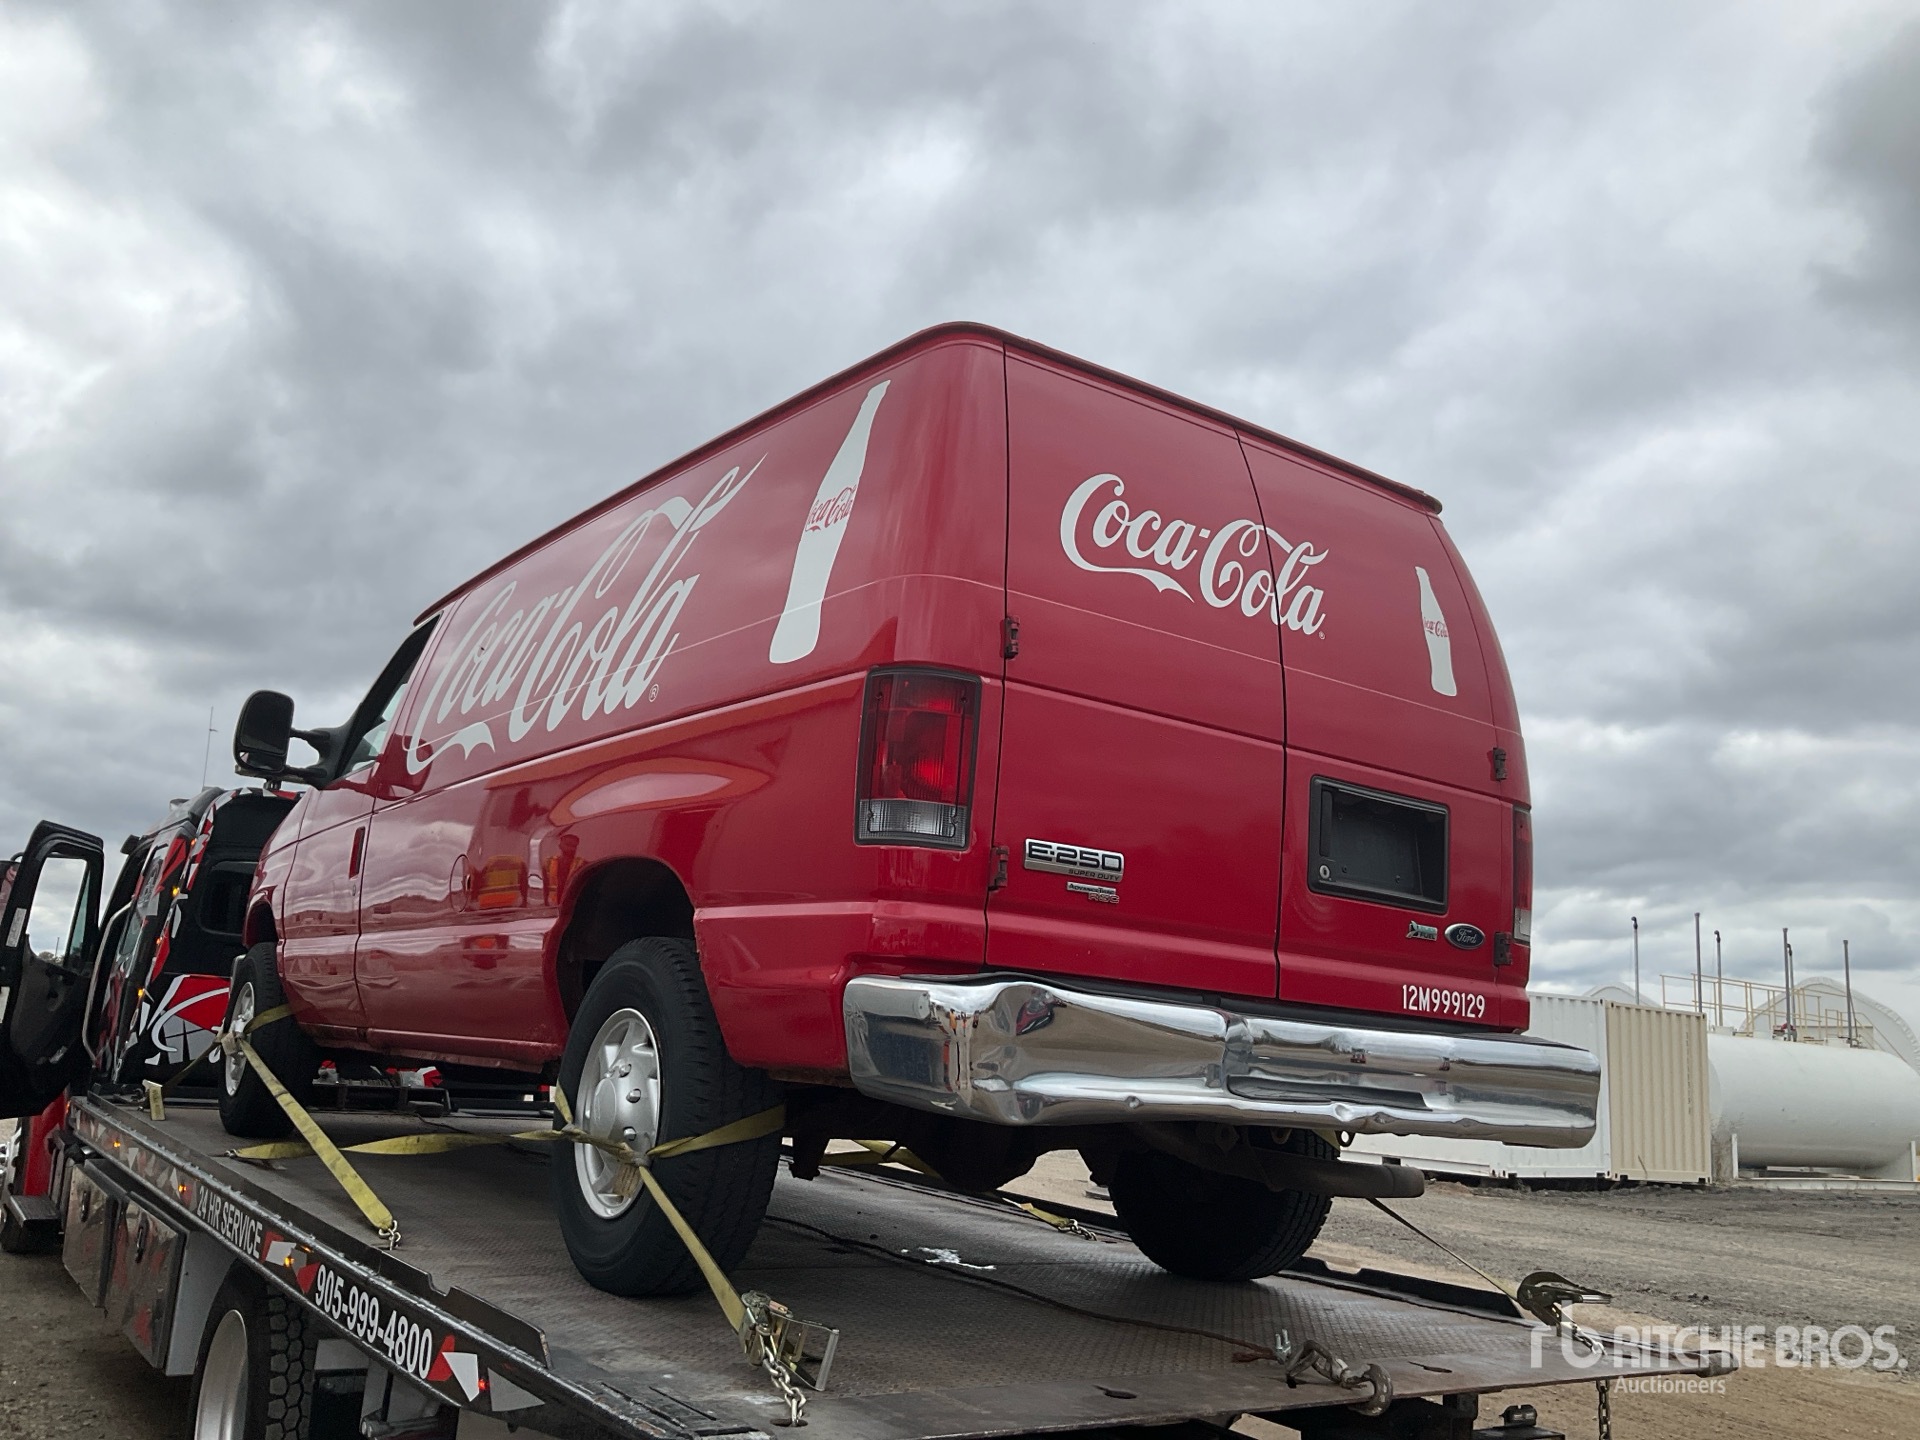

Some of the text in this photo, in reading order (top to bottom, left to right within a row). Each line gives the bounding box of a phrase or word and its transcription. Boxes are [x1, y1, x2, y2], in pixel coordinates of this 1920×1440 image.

[1060, 473, 1328, 636] Coca-Cola
[406, 452, 767, 775] Coca-Cola
[1068, 868, 1120, 881] SUPER DUTY
[1456, 928, 1477, 944] Ford
[1402, 984, 1485, 1018] 12M999129
[197, 1185, 263, 1259] 24 HR SERVICE
[315, 1264, 433, 1380] 905-999-4800
